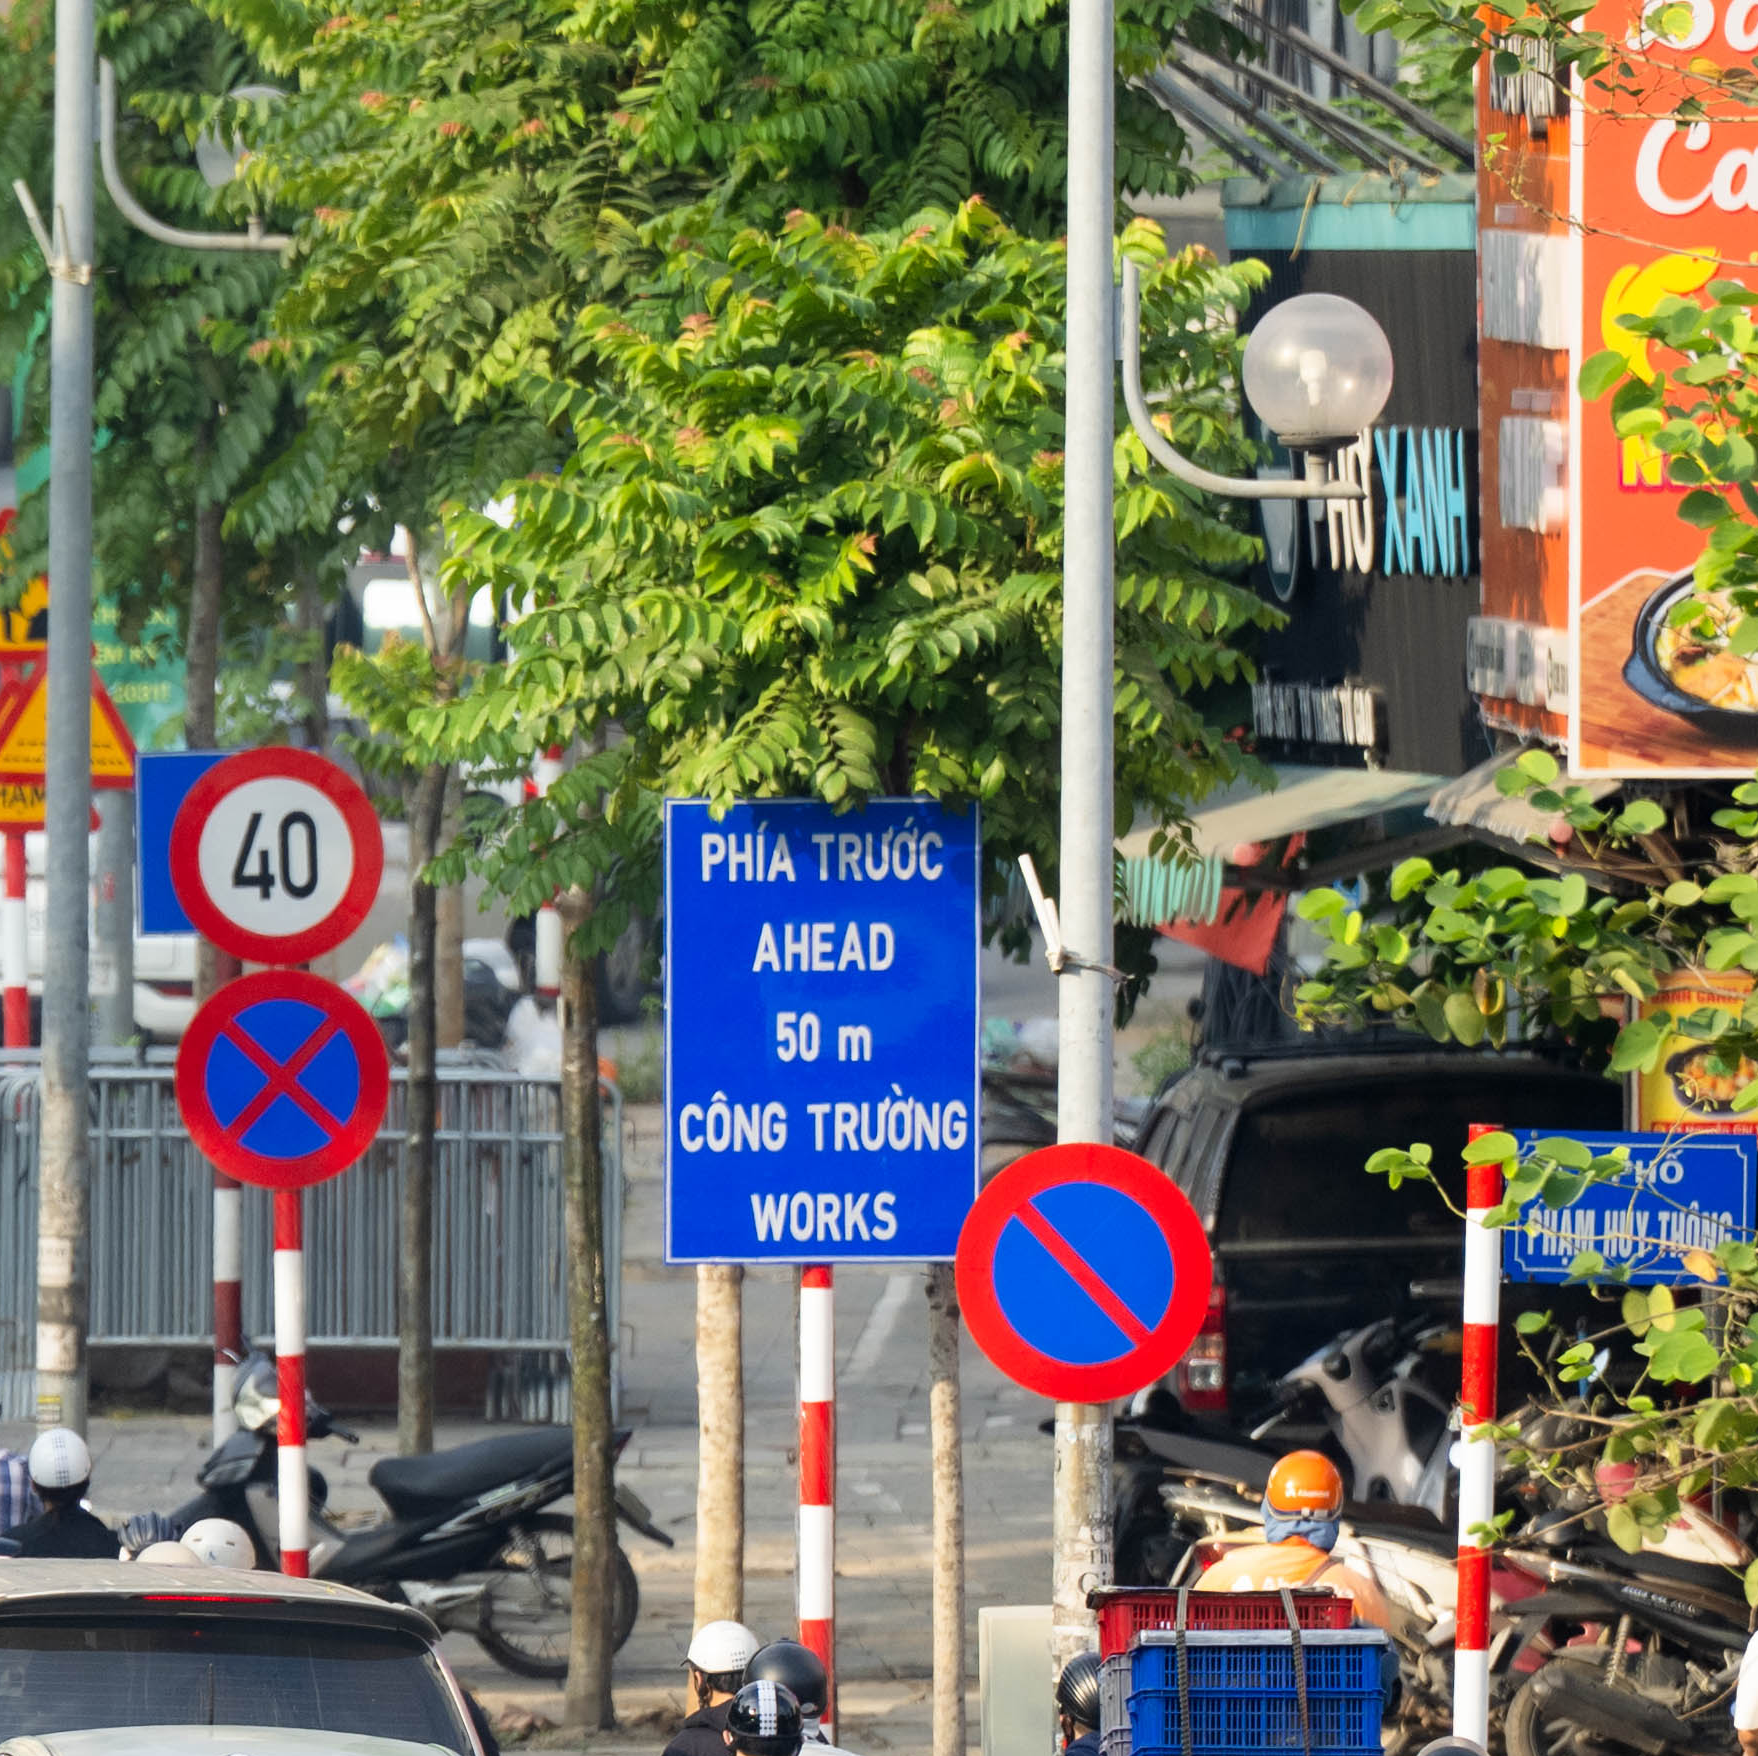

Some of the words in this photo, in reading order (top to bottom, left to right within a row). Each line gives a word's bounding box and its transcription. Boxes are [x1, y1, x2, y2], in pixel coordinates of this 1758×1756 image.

[1374, 424, 1469, 578] XANH
[232, 811, 317, 900] 40
[701, 820, 795, 882] PHÍA
[811, 816, 943, 882] TRƯỚC
[753, 921, 895, 973] AHEAD
[776, 1011, 821, 1063] 50
[838, 1025, 872, 1062] m
[679, 1090, 788, 1153] CÔNG
[806, 1083, 968, 1152] TRƯỜNG
[1611, 1151, 1684, 1185] PHỐ
[750, 1192, 898, 1242] WORKS
[1527, 1207, 1596, 1267] PHẠM
[1602, 1209, 1650, 1258] HUY
[1657, 1200, 1733, 1259] THÔNG
